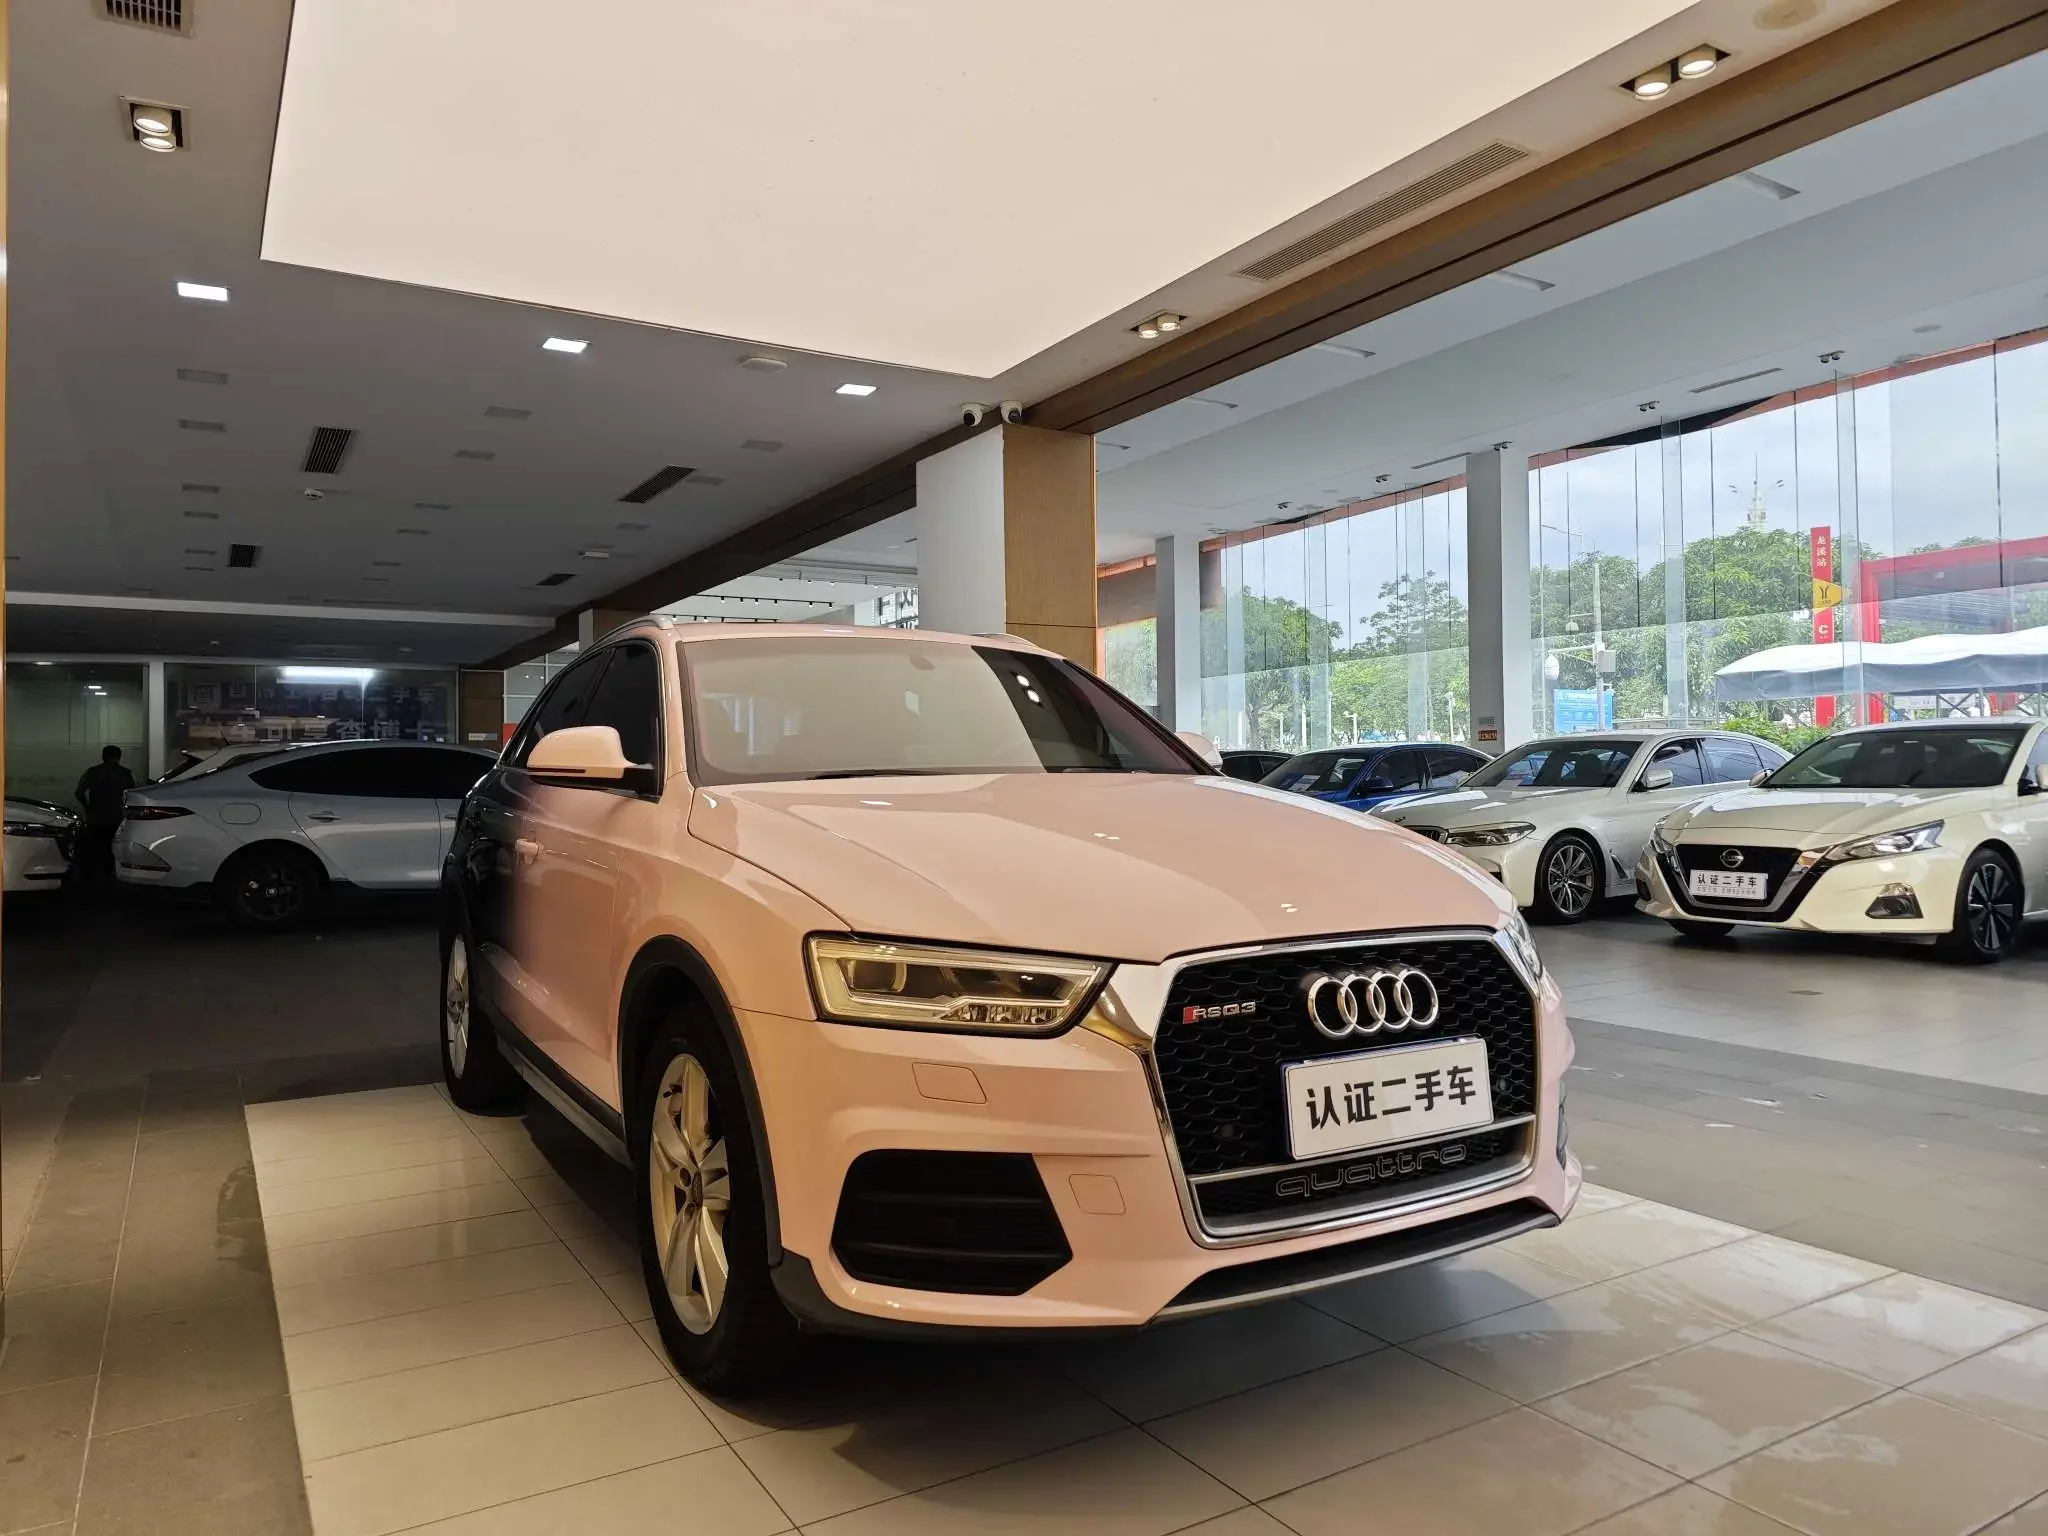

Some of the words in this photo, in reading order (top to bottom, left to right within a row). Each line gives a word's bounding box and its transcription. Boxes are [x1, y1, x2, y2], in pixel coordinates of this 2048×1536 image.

[1818, 624, 1829, 635] C
[1697, 873, 1757, 887] 认证二手车
[1191, 1001, 1256, 1020] RSQ3
[1306, 1066, 1477, 1131] 认证二手车
[1276, 1143, 1467, 1197] quattro
